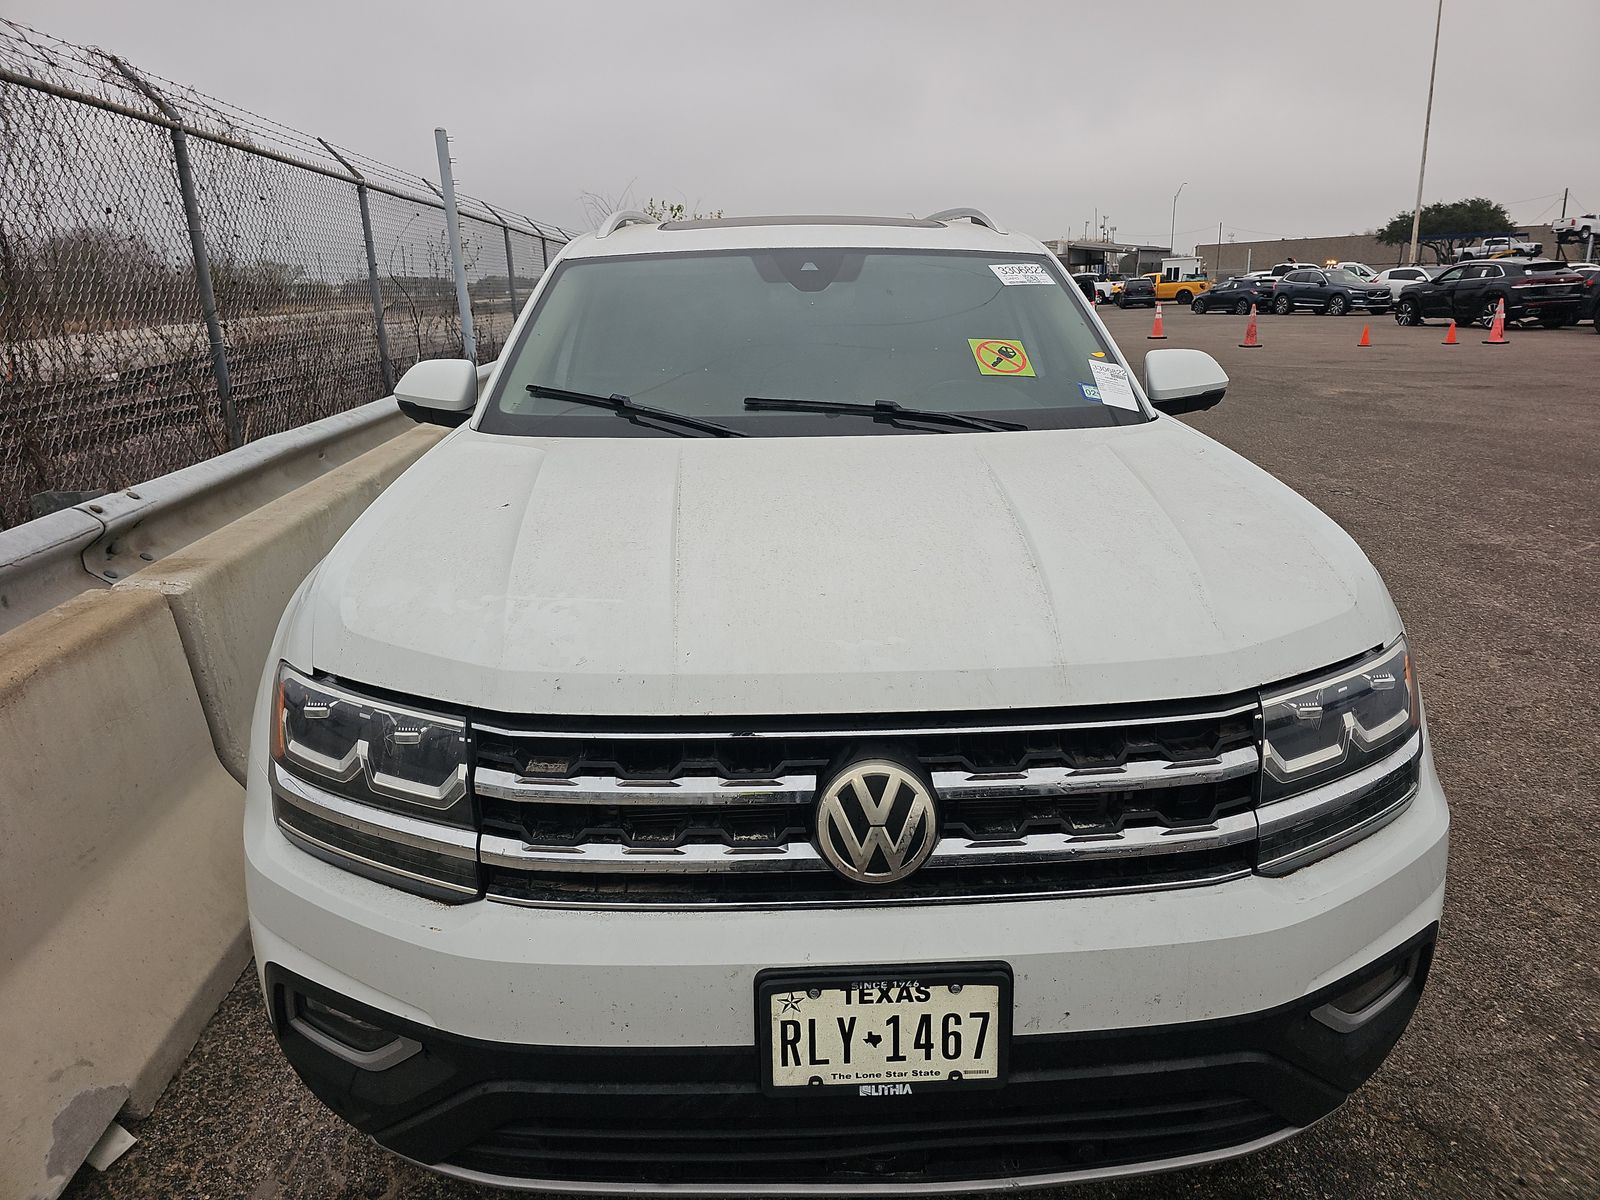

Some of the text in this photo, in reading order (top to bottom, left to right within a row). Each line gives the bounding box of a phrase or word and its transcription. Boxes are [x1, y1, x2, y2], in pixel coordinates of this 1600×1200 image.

[851, 981, 888, 990] SINCE
[840, 986, 931, 1005] TEXAS
[780, 1012, 990, 1067] RLY 1467
[911, 1069, 941, 1077] State
[871, 1083, 913, 1096] LITHIA
